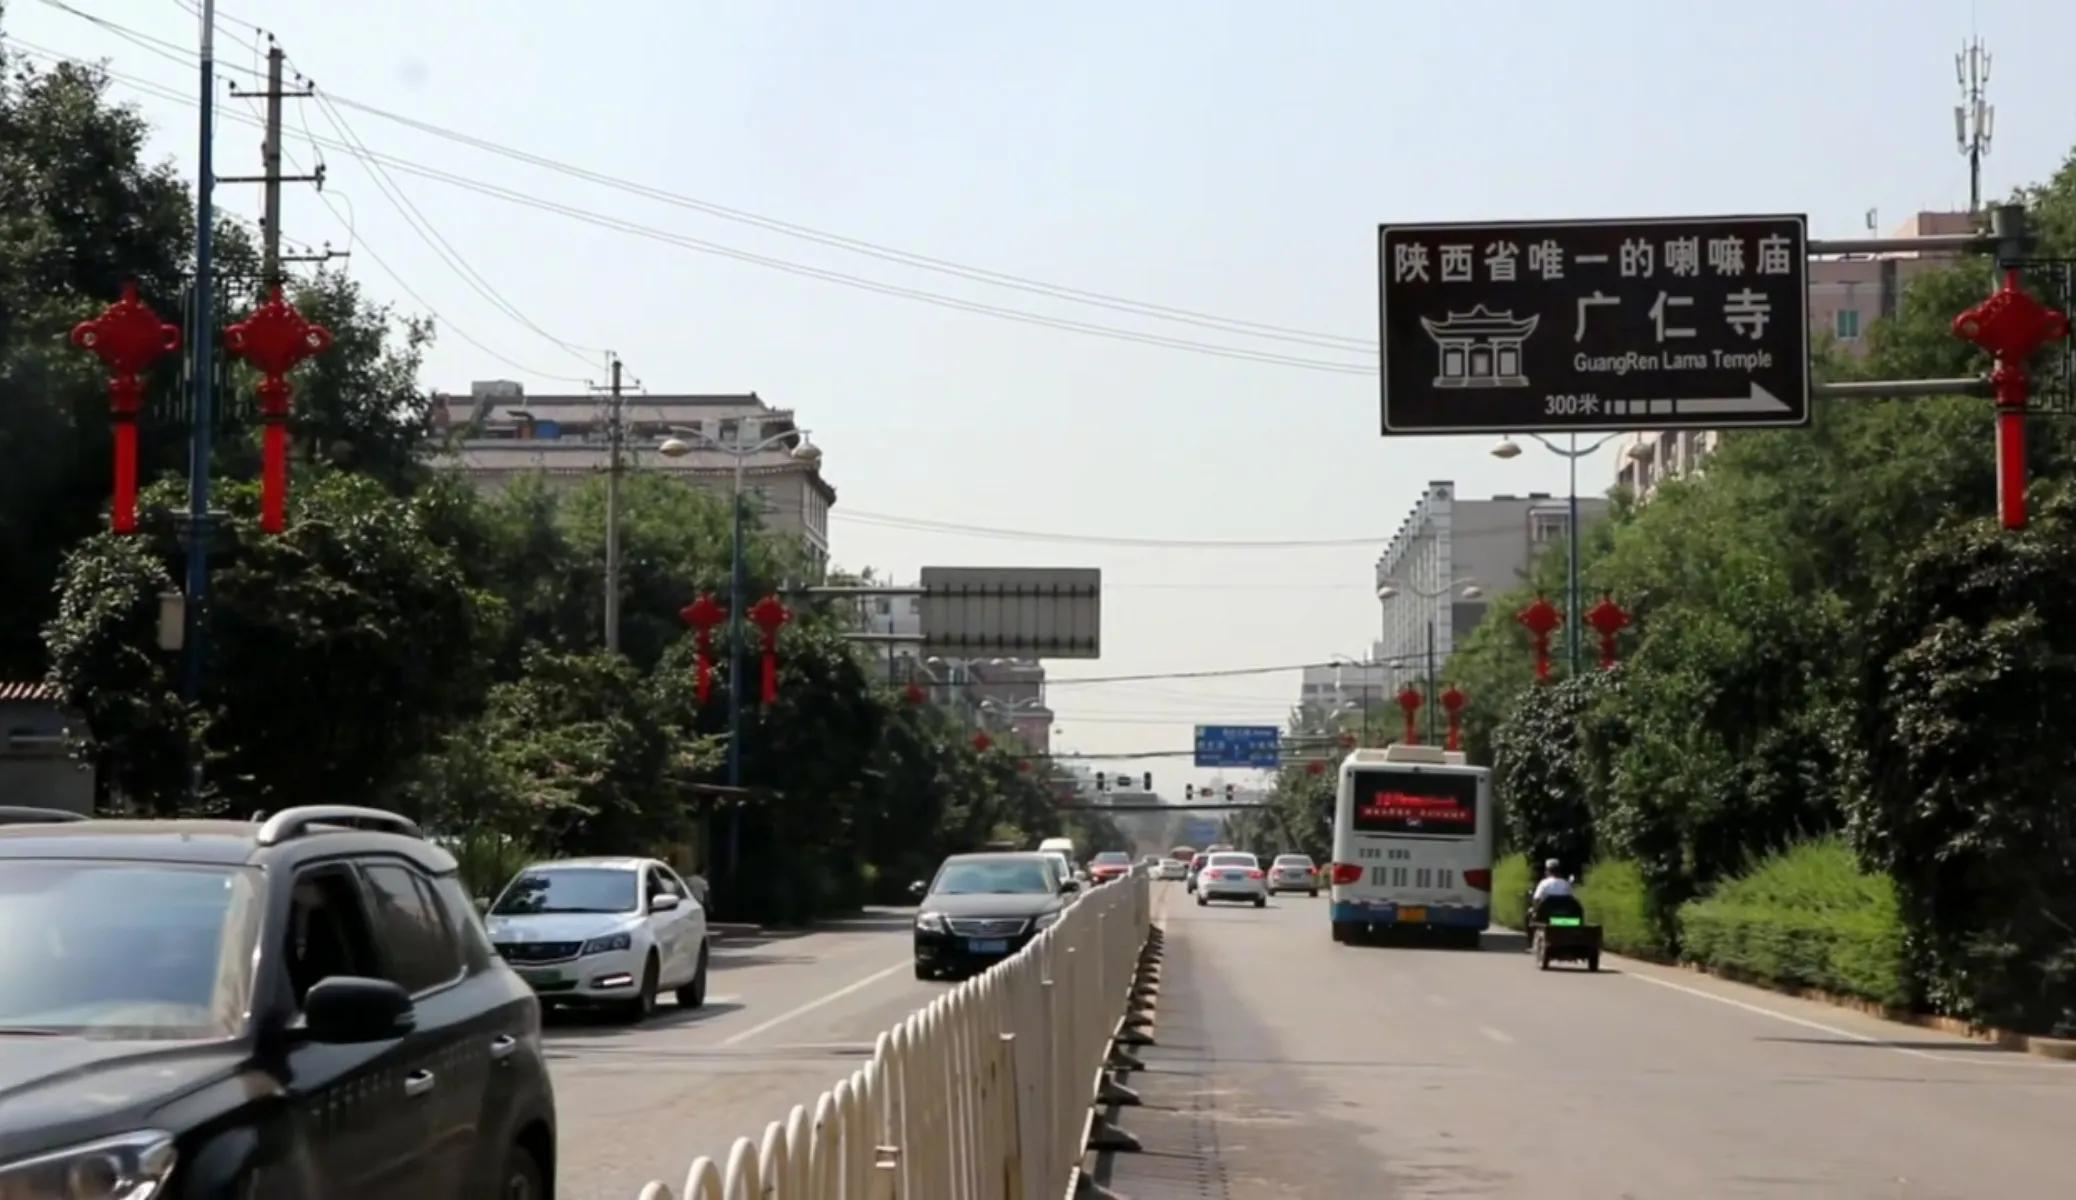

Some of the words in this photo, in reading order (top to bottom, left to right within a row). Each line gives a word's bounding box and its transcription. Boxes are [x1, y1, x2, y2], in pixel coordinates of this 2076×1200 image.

[1394, 233, 1791, 283] 陕西省唯一的喇嘛庙
[1574, 287, 1771, 342] 广仁寺
[1574, 352, 1658, 375] GuangRen
[1663, 351, 1707, 370] Lama
[1712, 349, 1772, 373] Temple
[1545, 393, 1599, 415] 300米
